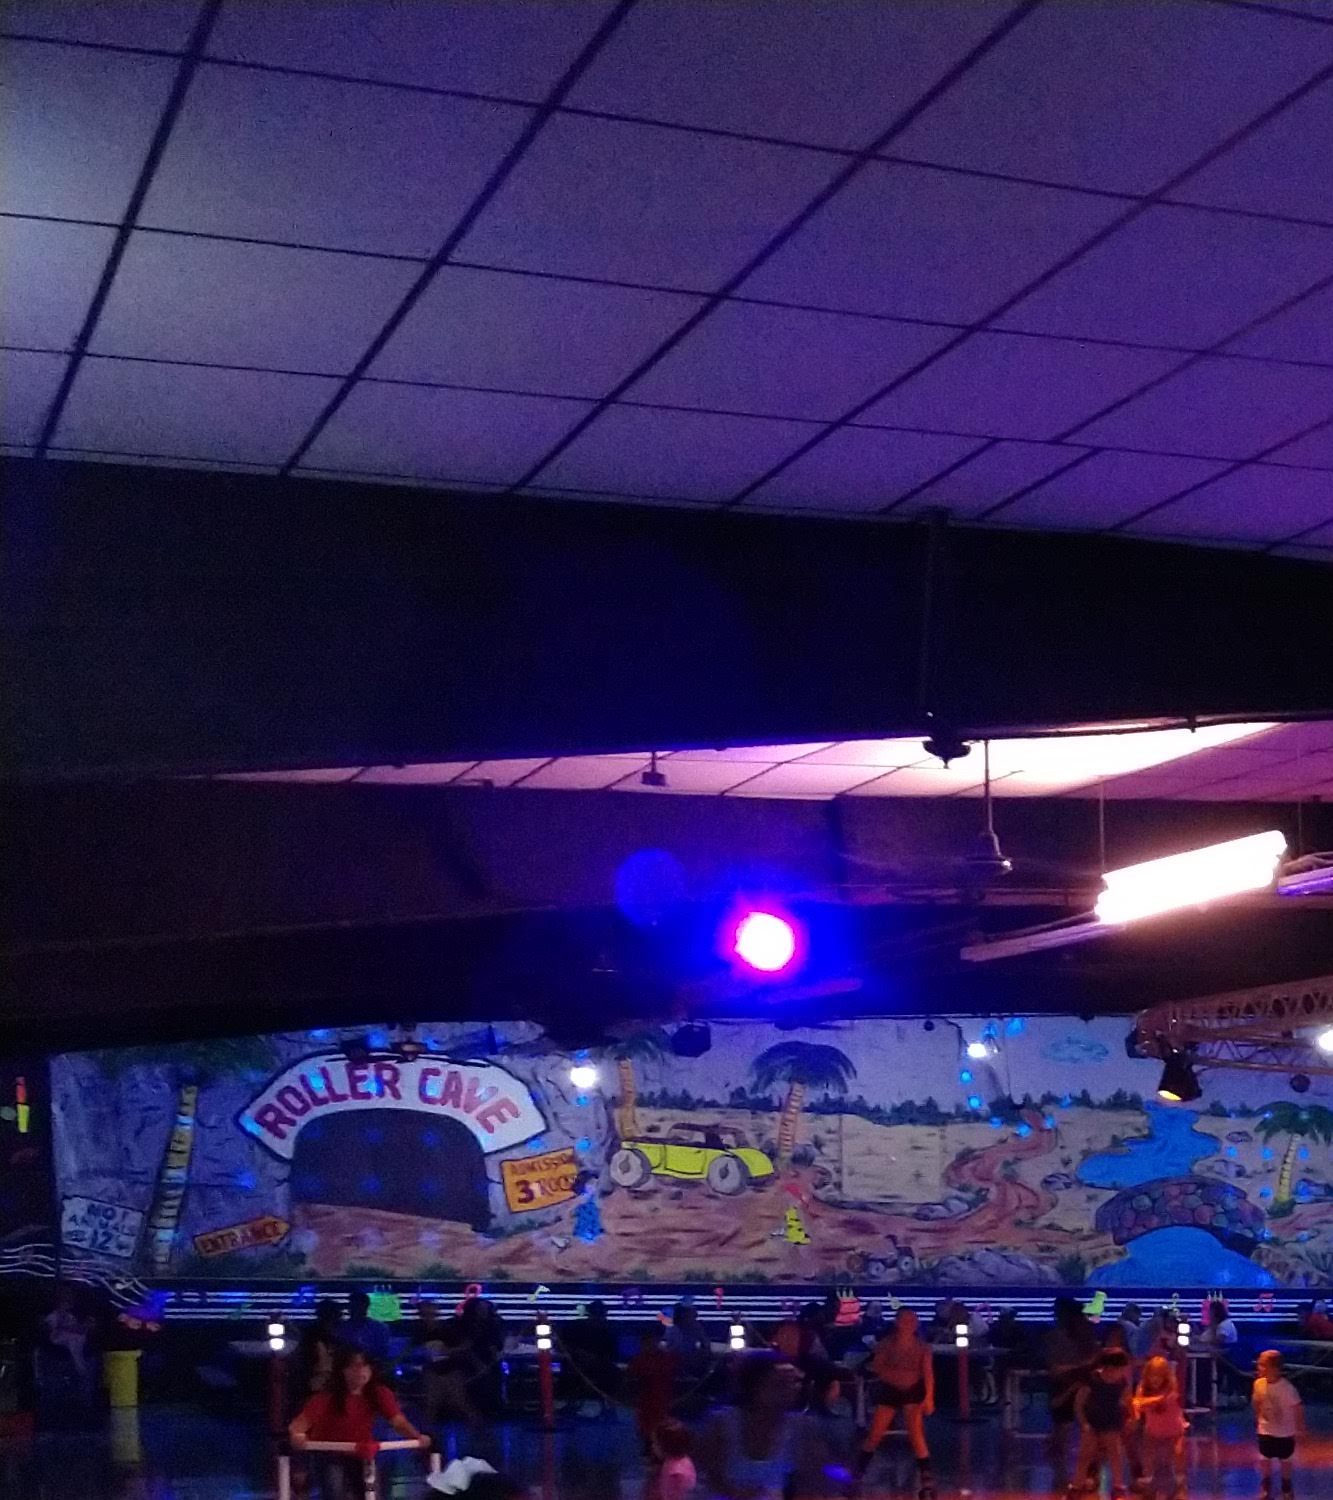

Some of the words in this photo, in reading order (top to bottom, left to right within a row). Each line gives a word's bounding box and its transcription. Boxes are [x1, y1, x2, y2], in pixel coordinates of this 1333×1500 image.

[254, 1063, 402, 1140] ROLLER
[419, 1067, 520, 1134] CAVE
[516, 1180, 535, 1204] 3
